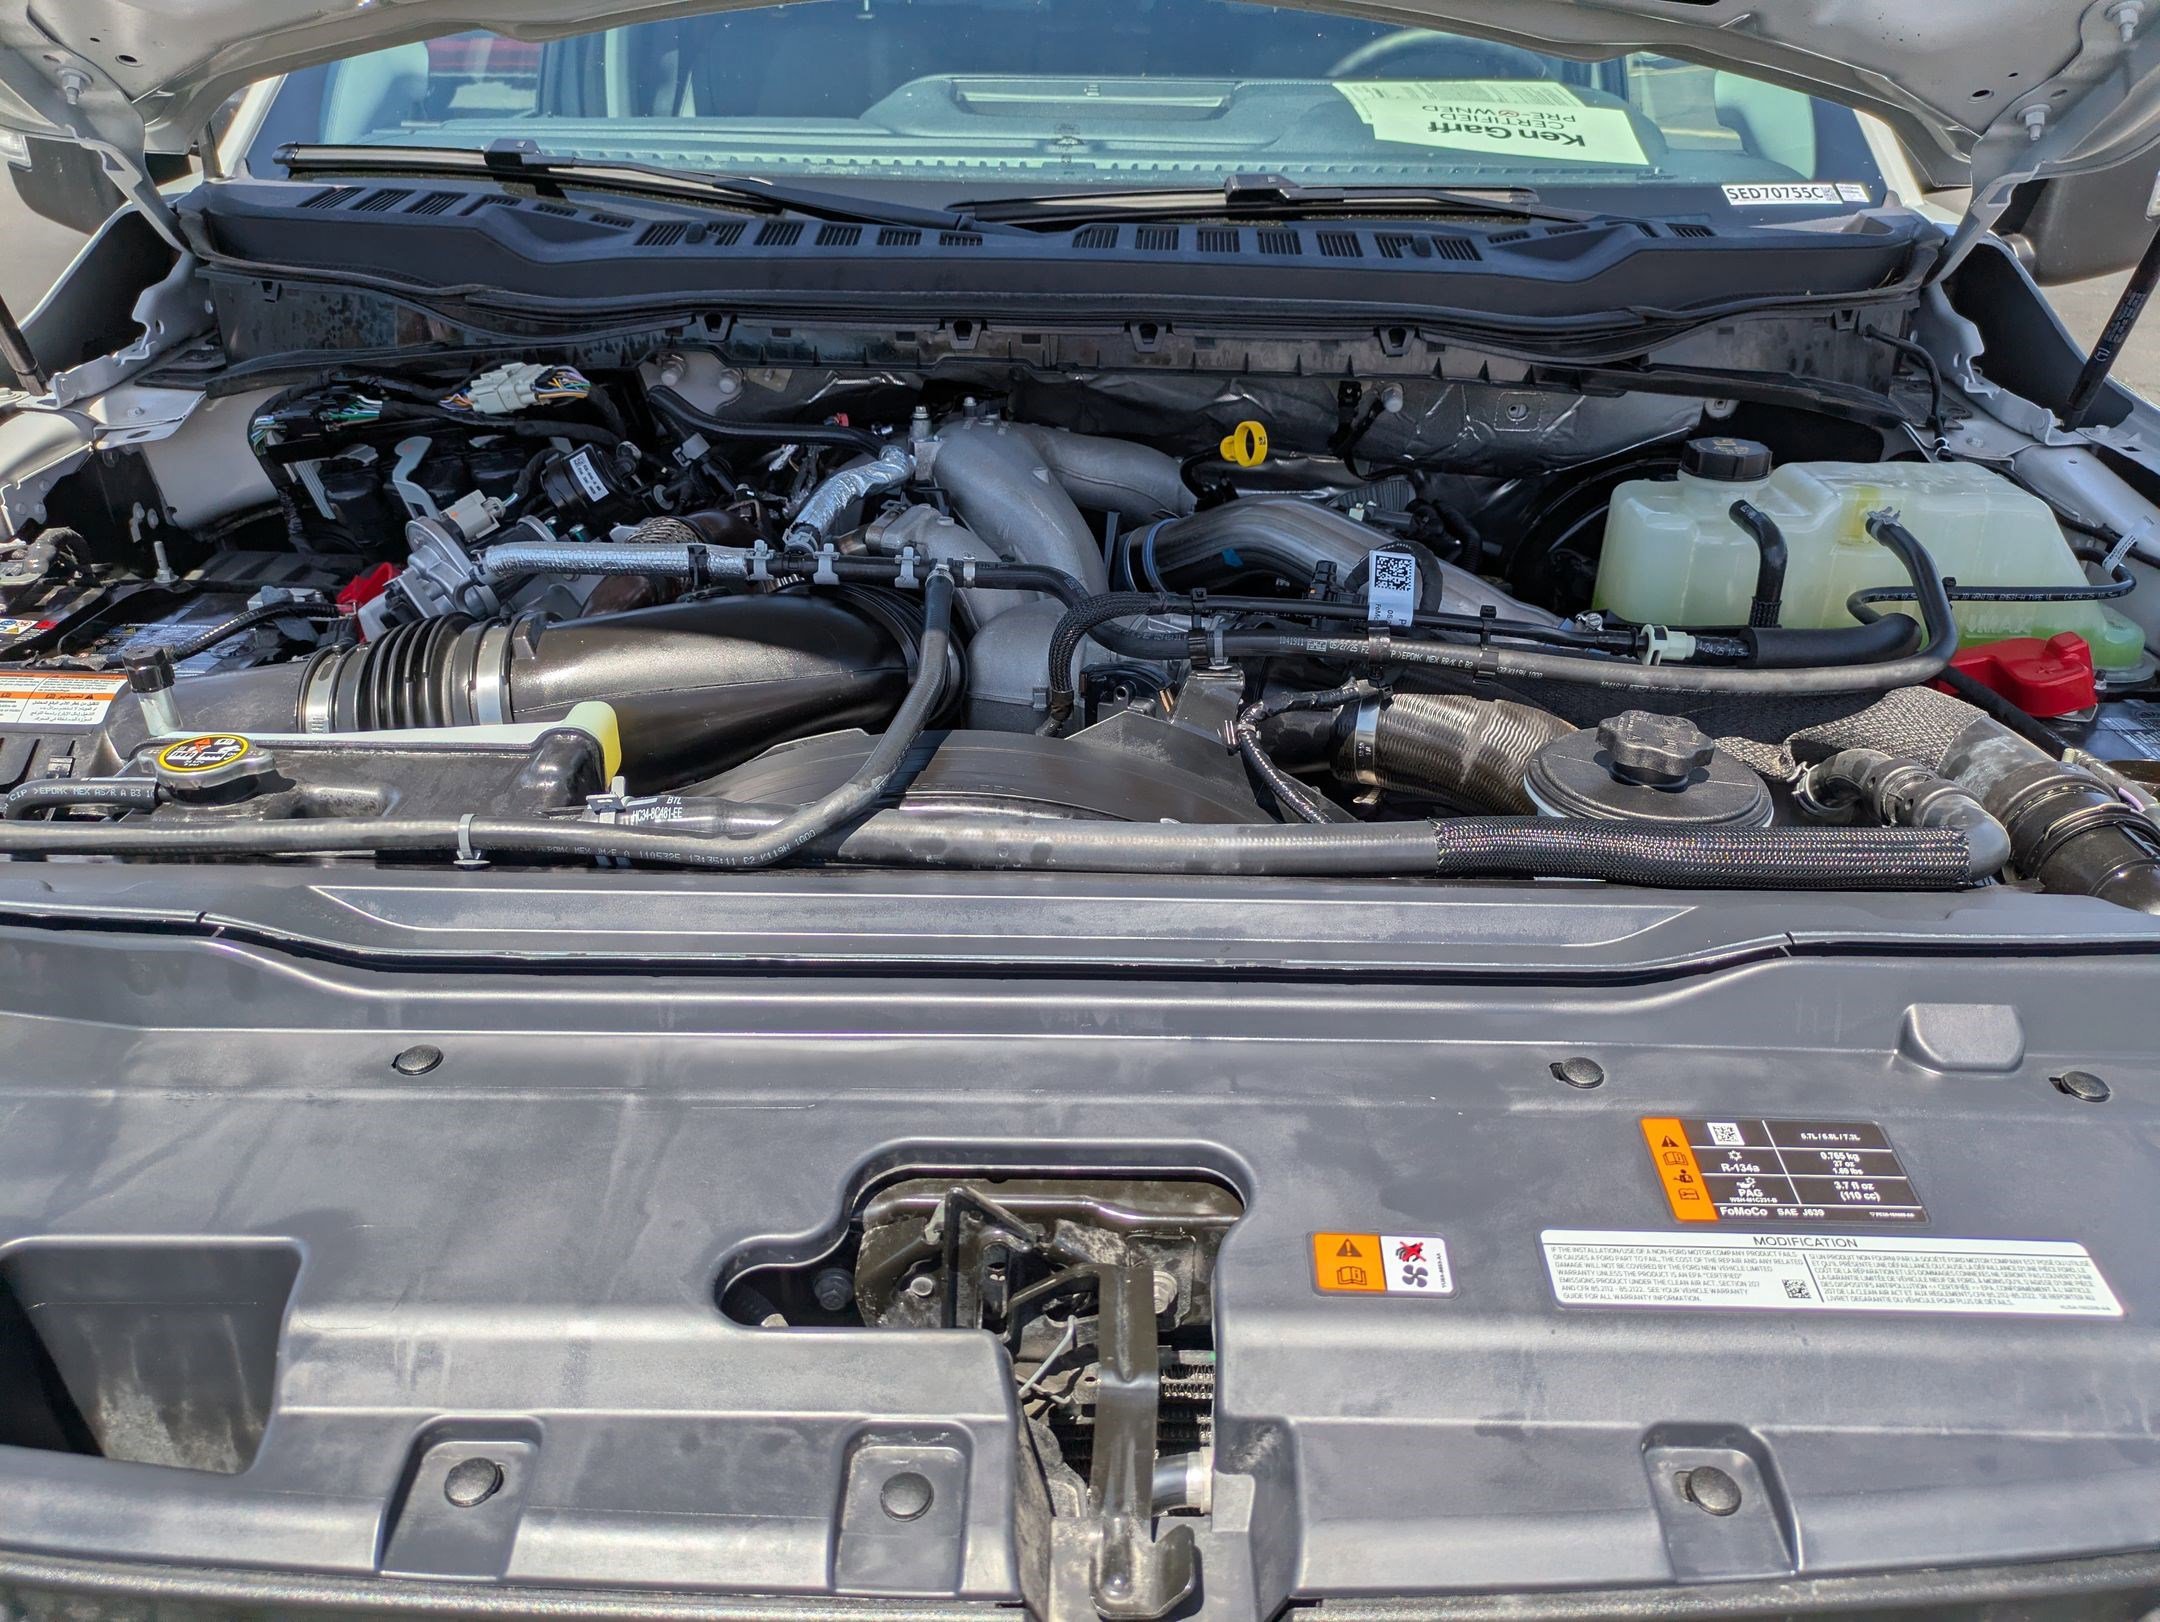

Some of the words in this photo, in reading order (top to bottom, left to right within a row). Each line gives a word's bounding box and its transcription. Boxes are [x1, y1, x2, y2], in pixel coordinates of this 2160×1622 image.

[1440, 113, 1565, 130] CERTIFIED
[1428, 121, 1513, 141] Garff
[1519, 126, 1585, 147] Ken
[1726, 187, 1823, 199] SED70755C
[73, 787, 89, 796] MEX
[666, 796, 682, 805] BTL
[1846, 1152, 1861, 1163] kg
[1720, 1163, 1760, 1173] R-134a
[1833, 1180, 1849, 1190] 3.7
[1861, 1182, 1875, 1190] oz
[1738, 1188, 1763, 1197] PAG
[1840, 1190, 1862, 1202] (110
[1863, 1192, 1881, 1203] cc)
[1719, 1206, 1768, 1216] FoMoCo
[1777, 1207, 1798, 1216] SAE
[1802, 1208, 1825, 1217] J639
[1753, 1236, 1858, 1248] MODIFICATION
[1557, 1268, 1595, 1276] WARRANTY
[1667, 1278, 1689, 1286] CLEAN
[1710, 1287, 1748, 1295] WARRANTY
